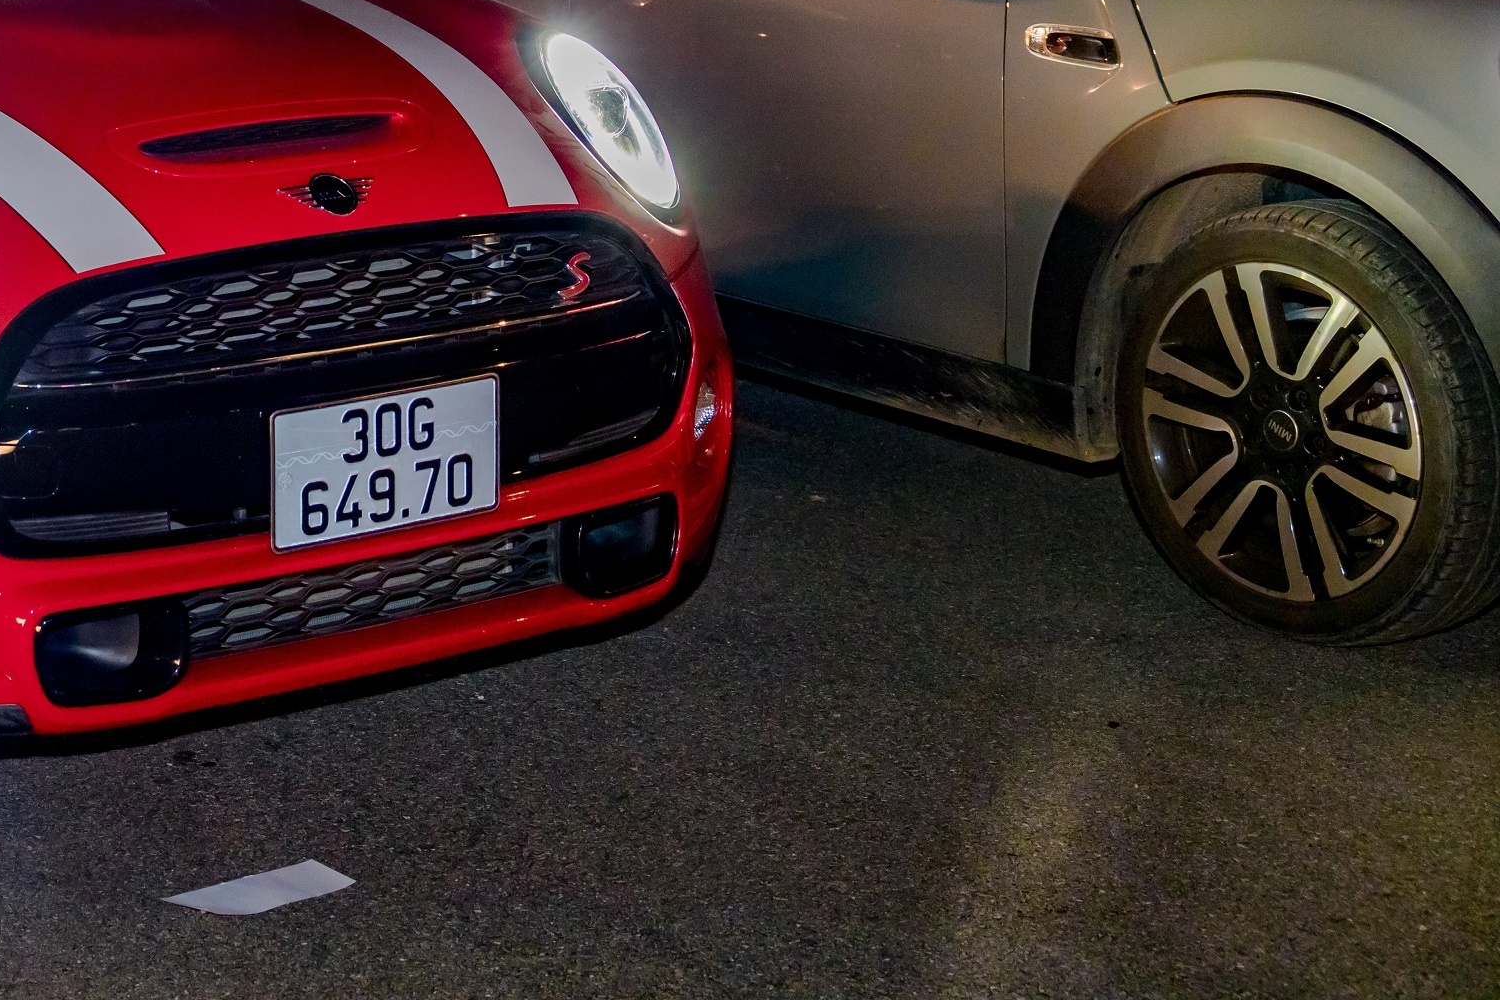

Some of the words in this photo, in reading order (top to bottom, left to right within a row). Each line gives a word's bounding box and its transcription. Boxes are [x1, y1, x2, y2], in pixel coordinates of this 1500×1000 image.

[557, 251, 591, 300] S
[341, 397, 435, 464] 30G
[1268, 418, 1293, 443] MINI
[301, 453, 473, 536] 649.70
